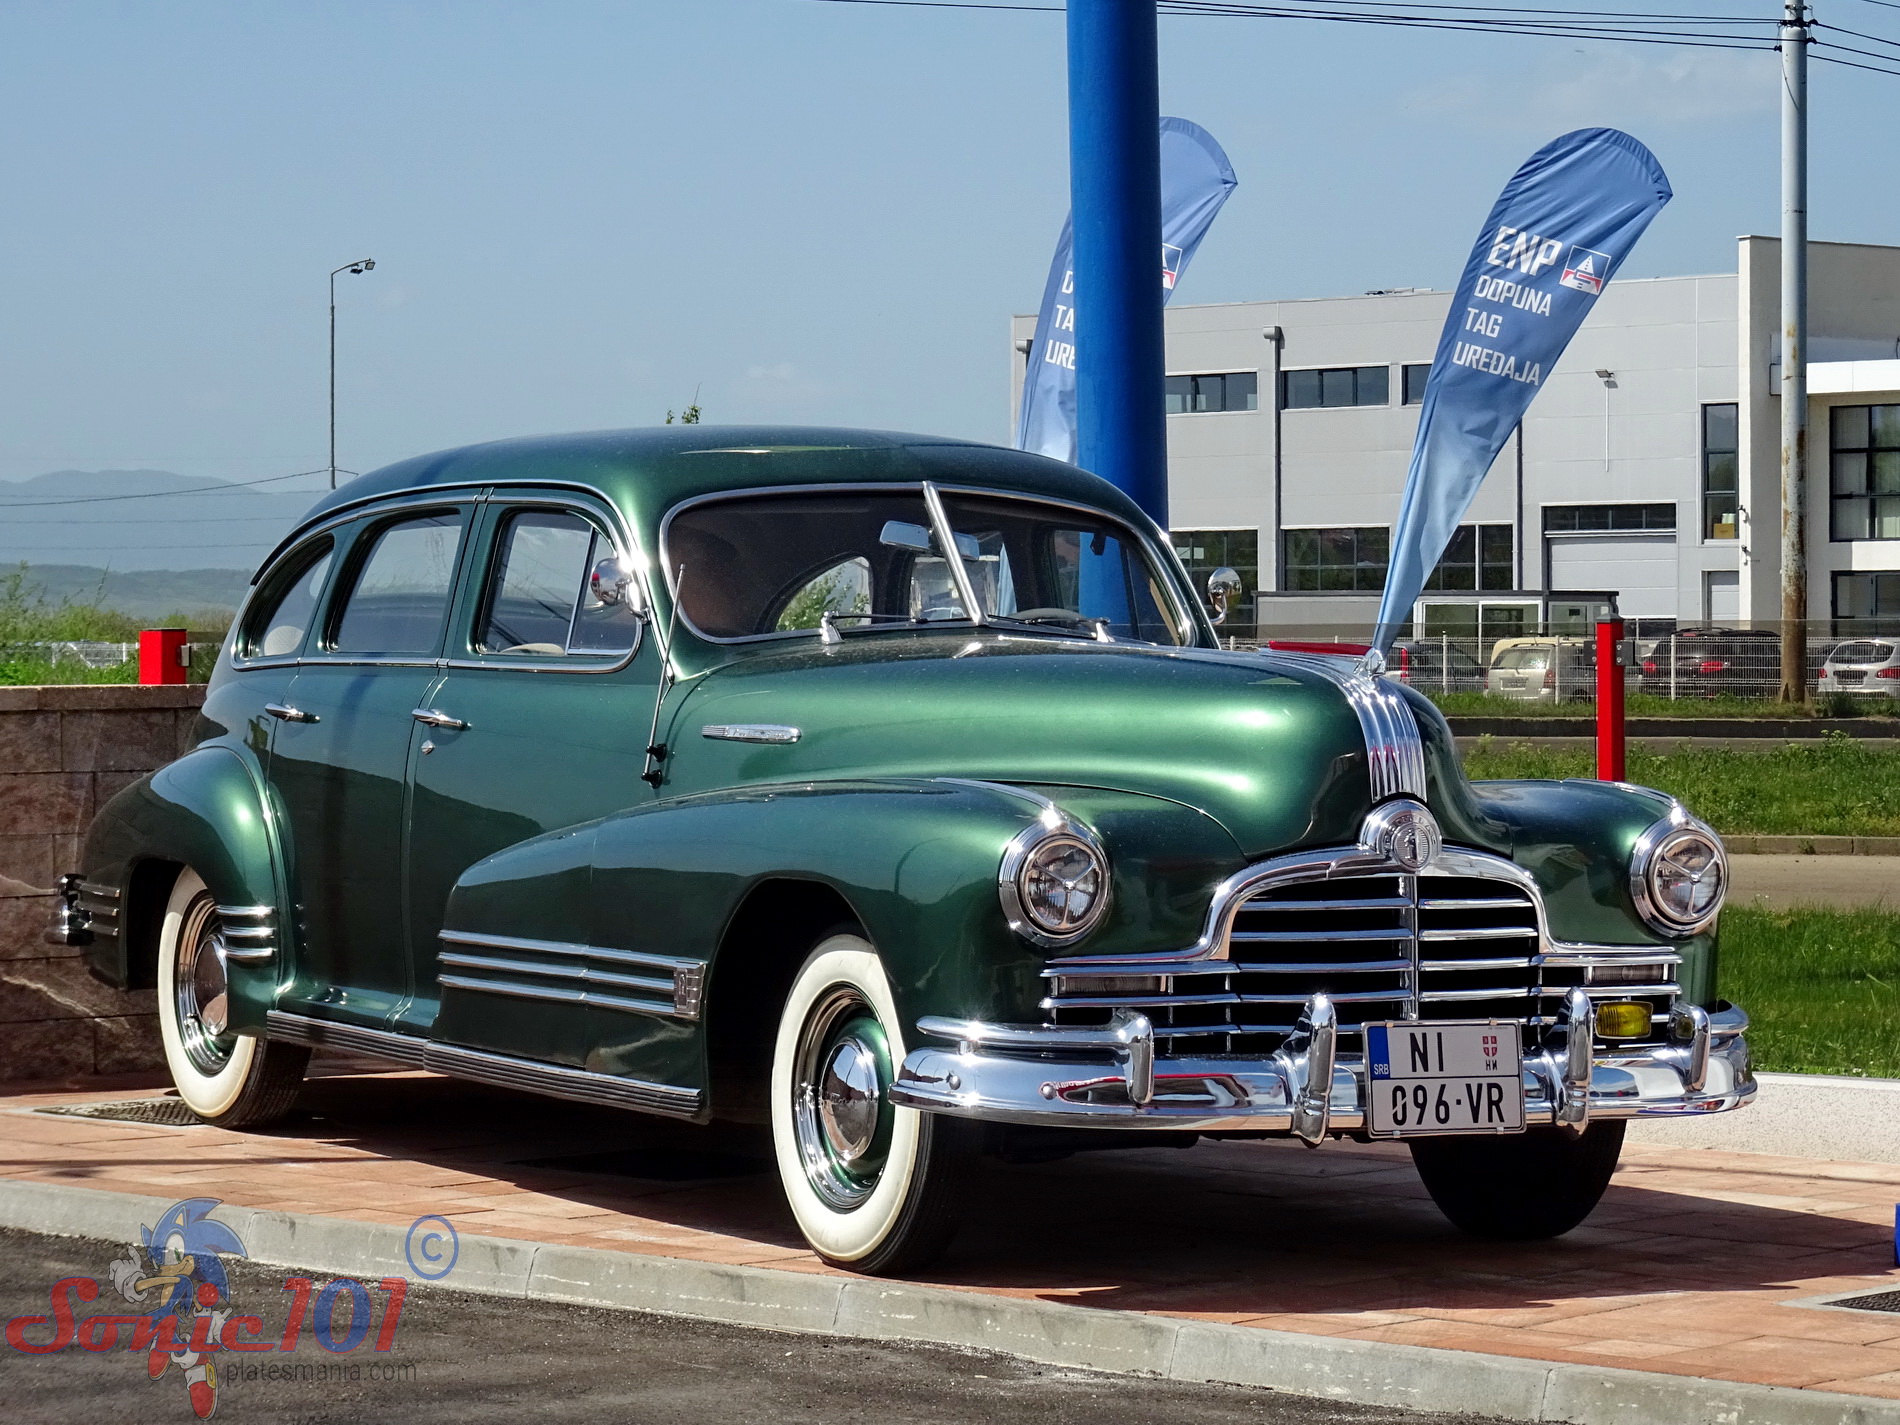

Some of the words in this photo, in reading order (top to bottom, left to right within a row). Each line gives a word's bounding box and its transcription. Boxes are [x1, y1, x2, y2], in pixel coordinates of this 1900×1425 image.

[1487, 225, 1563, 276] ENP
[1473, 274, 1552, 316] DOPUNA
[1055, 304, 1074, 332] TA
[1464, 307, 1503, 338] TAG
[1452, 341, 1541, 386] UREĐAJA
[1373, 1063, 1390, 1075] SRB
[1409, 1031, 1444, 1073] NI
